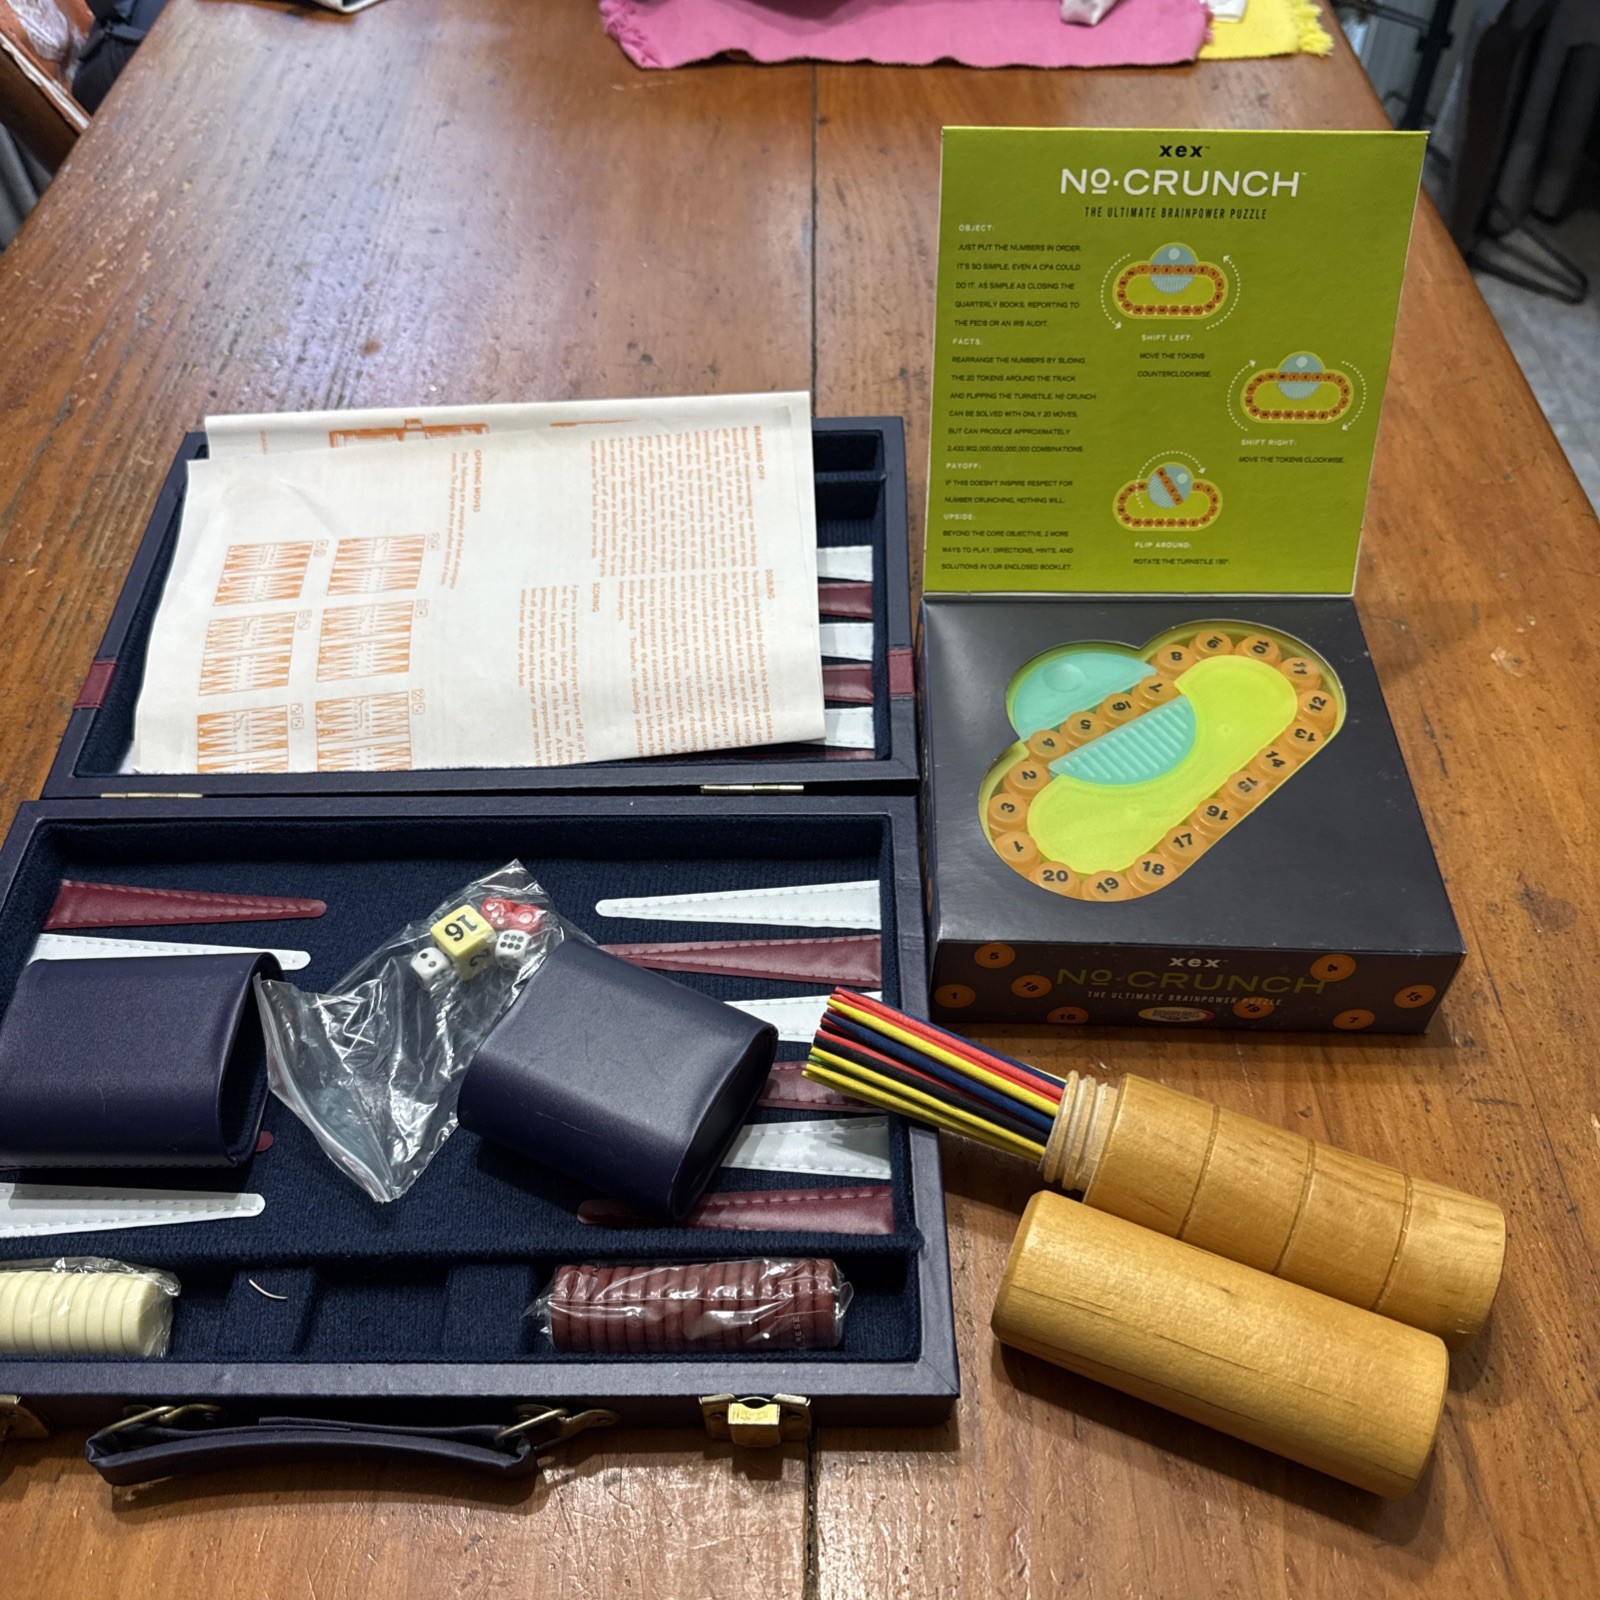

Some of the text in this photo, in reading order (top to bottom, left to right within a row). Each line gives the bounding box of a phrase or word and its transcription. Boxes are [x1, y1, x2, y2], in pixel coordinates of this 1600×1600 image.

[1085, 207, 1266, 219] THE ULTIMATE BRAINPOWER PUZZLE
[959, 243, 976, 251] JUST
[978, 243, 992, 251] PUT
[995, 243, 1008, 252] THE
[1010, 244, 1045, 252] NUMBERS
[1047, 244, 1054, 252] IN
[957, 262, 970, 270] IT'S
[972, 262, 982, 271] SO
[1012, 263, 1031, 271] EVEN
[1039, 263, 1054, 271] CPA
[1056, 263, 1081, 272] COULD
[956, 281, 1074, 291] DO AS SIMPLE AS CLOSING THE
[955, 300, 997, 309] QUARTERLY
[1028, 301, 1068, 309] REPORTING
[1070, 301, 1080, 309] TO
[954, 319, 968, 327] THE
[970, 319, 987, 327] FEDS
[989, 319, 999, 327] OR
[1001, 319, 1011, 327] AN
[1013, 319, 1024, 328] IRS
[1141, 333, 1166, 342] SHIFT
[952, 356, 1085, 365] REARRANGE THE NUMBERS BY SLIDING
[1140, 352, 1205, 360] MOVE THE TOKENS
[952, 374, 1075, 383] THE 20 TOKENS AROUND THE TRACK
[950, 392, 965, 400] AND
[966, 392, 997, 400] FLIPPING
[999, 392, 1011, 400] THE
[1066, 393, 1096, 401] CRUNCH
[949, 409, 963, 417] CAN
[965, 410, 974, 418] BE
[976, 410, 1003, 418] SOLVED
[1023, 410, 1041, 418] ONLY
[1043, 410, 1051, 418] 20
[948, 427, 1070, 436] BUT CAN PRODUCE APPROXIMATELY
[1241, 438, 1265, 446] SHIFT
[1239, 455, 1258, 463] MOVE
[1261, 455, 1274, 464] THE
[1276, 456, 1303, 464] TOKENS
[953, 479, 968, 487] THIS
[970, 479, 998, 487] DOESN'T
[944, 496, 972, 504] NUMBER
[1017, 496, 1047, 504] NOTHING
[943, 529, 970, 537] BEYOND
[972, 529, 985, 537] THE
[986, 530, 1004, 538] CORE
[1045, 530, 1049, 538] 2
[1050, 530, 1069, 538] MORE
[942, 546, 961, 554] WAYS
[963, 546, 971, 554] TO
[1135, 541, 1153, 549] FLIP
[1004, 563, 1039, 571] ENCLOSED
[1177, 558, 1213, 566] TURNSTILE
[1252, 640, 1269, 655] 10
[1170, 651, 1183, 662] 8
[1293, 662, 1308, 675] 11
[1148, 683, 1163, 693] 7
[1308, 696, 1327, 711] 12
[1080, 719, 1092, 731] 5
[1294, 728, 1316, 742] 13
[1042, 737, 1056, 748] 4
[1265, 750, 1286, 768] 14
[1021, 770, 1037, 780] 2
[1237, 777, 1258, 793] 15
[1000, 802, 1015, 813] 3
[1206, 805, 1229, 821] 16
[1173, 832, 1193, 849] 17
[1142, 860, 1165, 876] 18
[1042, 869, 1069, 883] 20
[1096, 877, 1119, 894] 19
[445, 914, 477, 942] 16
[989, 952, 1000, 960] 5
[1327, 963, 1338, 972] 4
[1022, 981, 1039, 992] 18
[1087, 990, 1282, 1006] THE ULTIMATE BRAINPOWER PUZZLE
